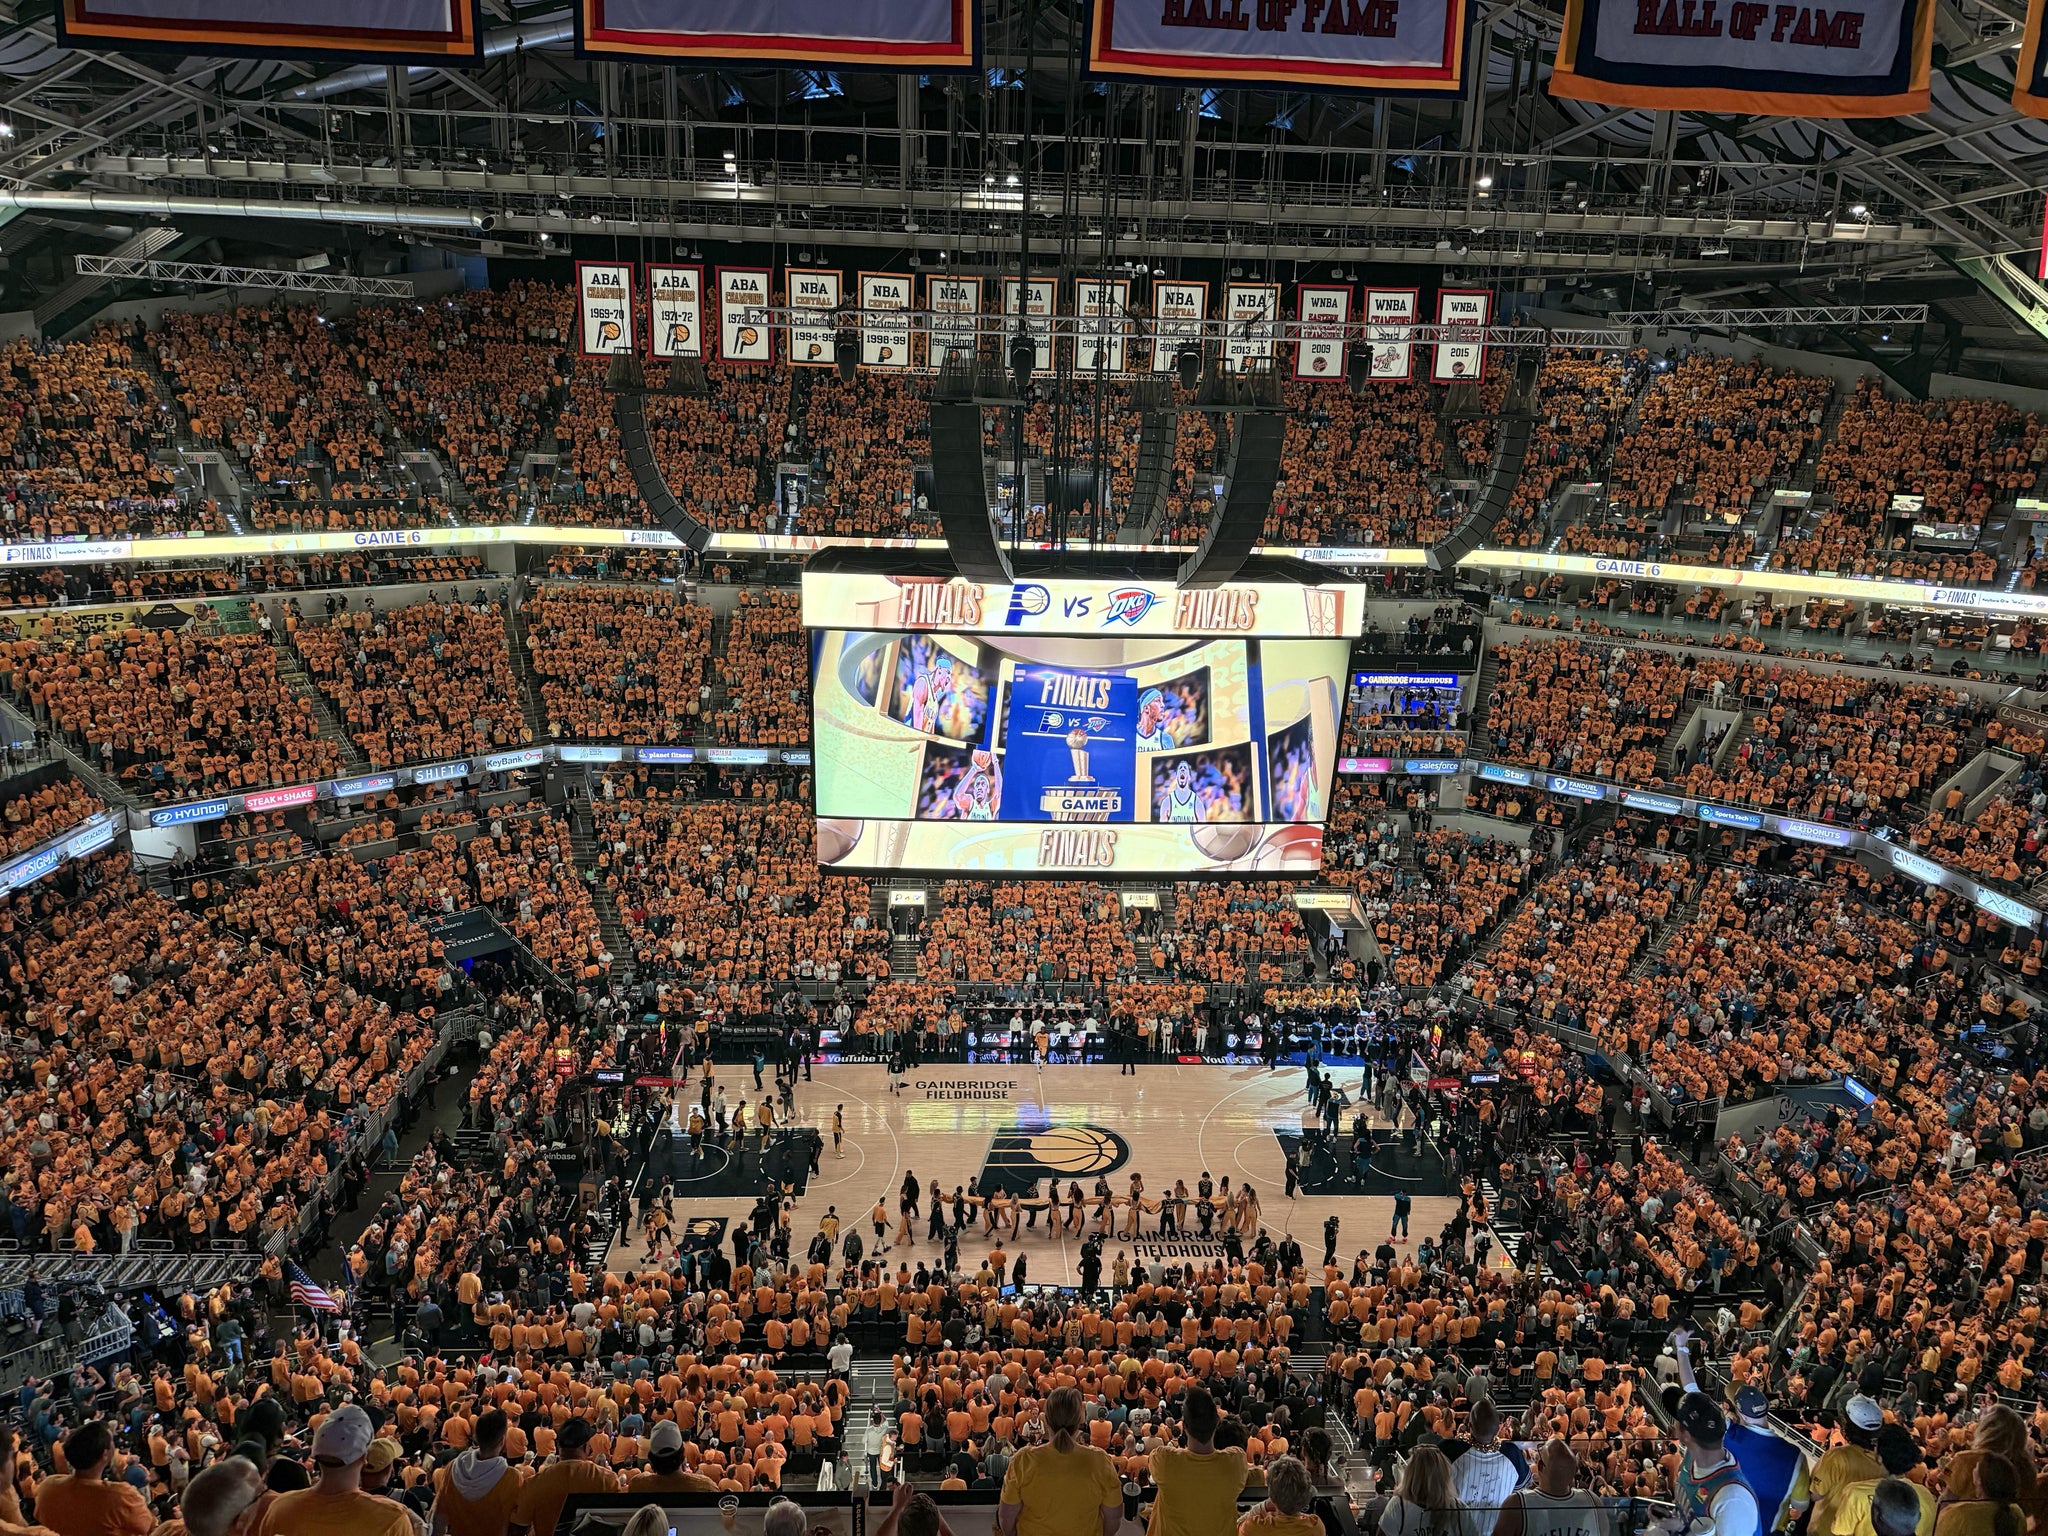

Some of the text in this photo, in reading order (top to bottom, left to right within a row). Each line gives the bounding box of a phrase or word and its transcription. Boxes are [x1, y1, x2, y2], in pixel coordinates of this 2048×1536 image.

[1161, 0, 1398, 38] HALL OF FAME
[1633, 0, 1865, 49] HALL OF FAME
[591, 273, 620, 286] ABA
[661, 276, 691, 289] ABA
[730, 279, 759, 291] ABA
[586, 286, 626, 299] CHAMPIONS
[800, 282, 828, 295] NBA
[873, 285, 900, 298] NBA
[940, 287, 968, 300] NBA
[656, 289, 696, 302] CHAMPIONS
[725, 292, 764, 305] CHAMPIONS
[795, 296, 833, 306] CENTRAL
[1165, 292, 1194, 305] NBA
[1236, 294, 1267, 307] NBA
[868, 299, 904, 309] CENTRAL
[936, 301, 972, 311] CENTRAL
[1311, 297, 1338, 308] WNBA
[1375, 299, 1407, 311] WNBA
[1451, 302, 1478, 313] WNBA
[590, 308, 625, 320] 1969-70
[1162, 307, 1196, 317] CENTRAL
[1308, 313, 1339, 322] EASTERN
[1371, 315, 1410, 324] CHAMPIONS
[1447, 317, 1478, 325] EASTERN
[795, 332, 836, 342] 1994-95
[867, 334, 906, 345] 1998-99
[1312, 344, 1331, 354] 2009
[1450, 348, 1469, 357] 2015
[354, 531, 421, 545] GAME 6
[641, 533, 663, 543] FINALS
[22, 546, 52, 560] FINALS
[1312, 549, 1333, 560] FINALS
[1595, 560, 1660, 576] GAME 6
[1946, 590, 1976, 605] FINALS
[900, 583, 983, 625] FINALS
[1113, 593, 1147, 618] OKC
[1174, 588, 1257, 629] FINALS
[1368, 676, 1409, 684] GAINBRIDGE
[1040, 674, 1111, 709] FINALS
[2012, 711, 2048, 728] LEXUS
[486, 755, 523, 768] KeyBank
[671, 751, 693, 759] fitness
[416, 764, 466, 781] SHIFT 4
[1419, 761, 1458, 771] salesforce
[1569, 781, 1598, 791] FANDUEL
[247, 796, 276, 807] STEAK
[284, 791, 313, 801] SHAKE
[1062, 799, 1118, 810] GAME 6
[1627, 794, 1681, 810] Fanatics Sportsbook
[175, 803, 228, 820] HYUNDAI
[1714, 810, 1760, 824] Sports Tech HQ
[1807, 827, 1841, 839] DONUTS
[1038, 829, 1117, 867] FINALS
[9, 850, 58, 881] SHIPSIGMA
[1911, 859, 1941, 876] CITY WIDE
[430, 921, 463, 933] CareSource
[445, 931, 495, 948] reSource
[827, 1055, 893, 1063] YouTube TV
[915, 1080, 1018, 1090] GAINBRIDGE
[926, 1090, 1009, 1100] FIELDHOUSE
[1133, 1244, 1225, 1258] FIELDHOUS
